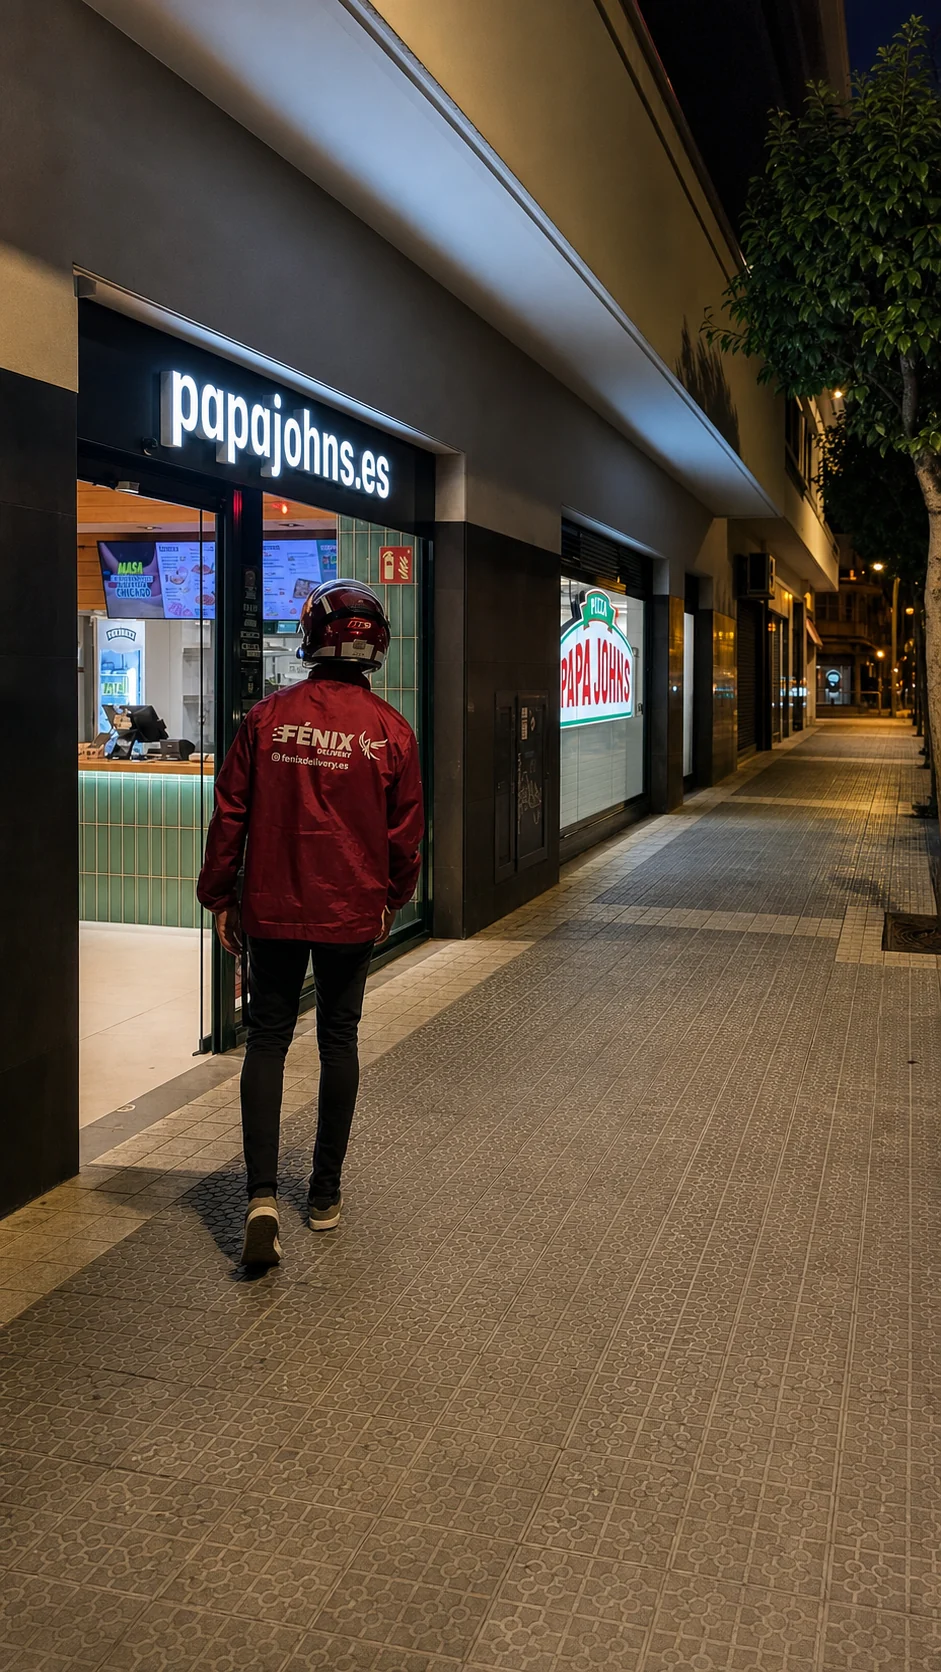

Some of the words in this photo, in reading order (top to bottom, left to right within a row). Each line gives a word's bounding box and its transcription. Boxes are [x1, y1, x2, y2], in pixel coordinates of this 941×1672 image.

[172, 370, 389, 499] papajohns.es
[118, 562, 143, 575] MASA
[590, 597, 607, 617] PIZZA
[561, 639, 591, 708] PAPA
[594, 638, 630, 705] JOHNS
[273, 722, 355, 751] FÉNIX
[317, 748, 352, 759] DELIVERY
